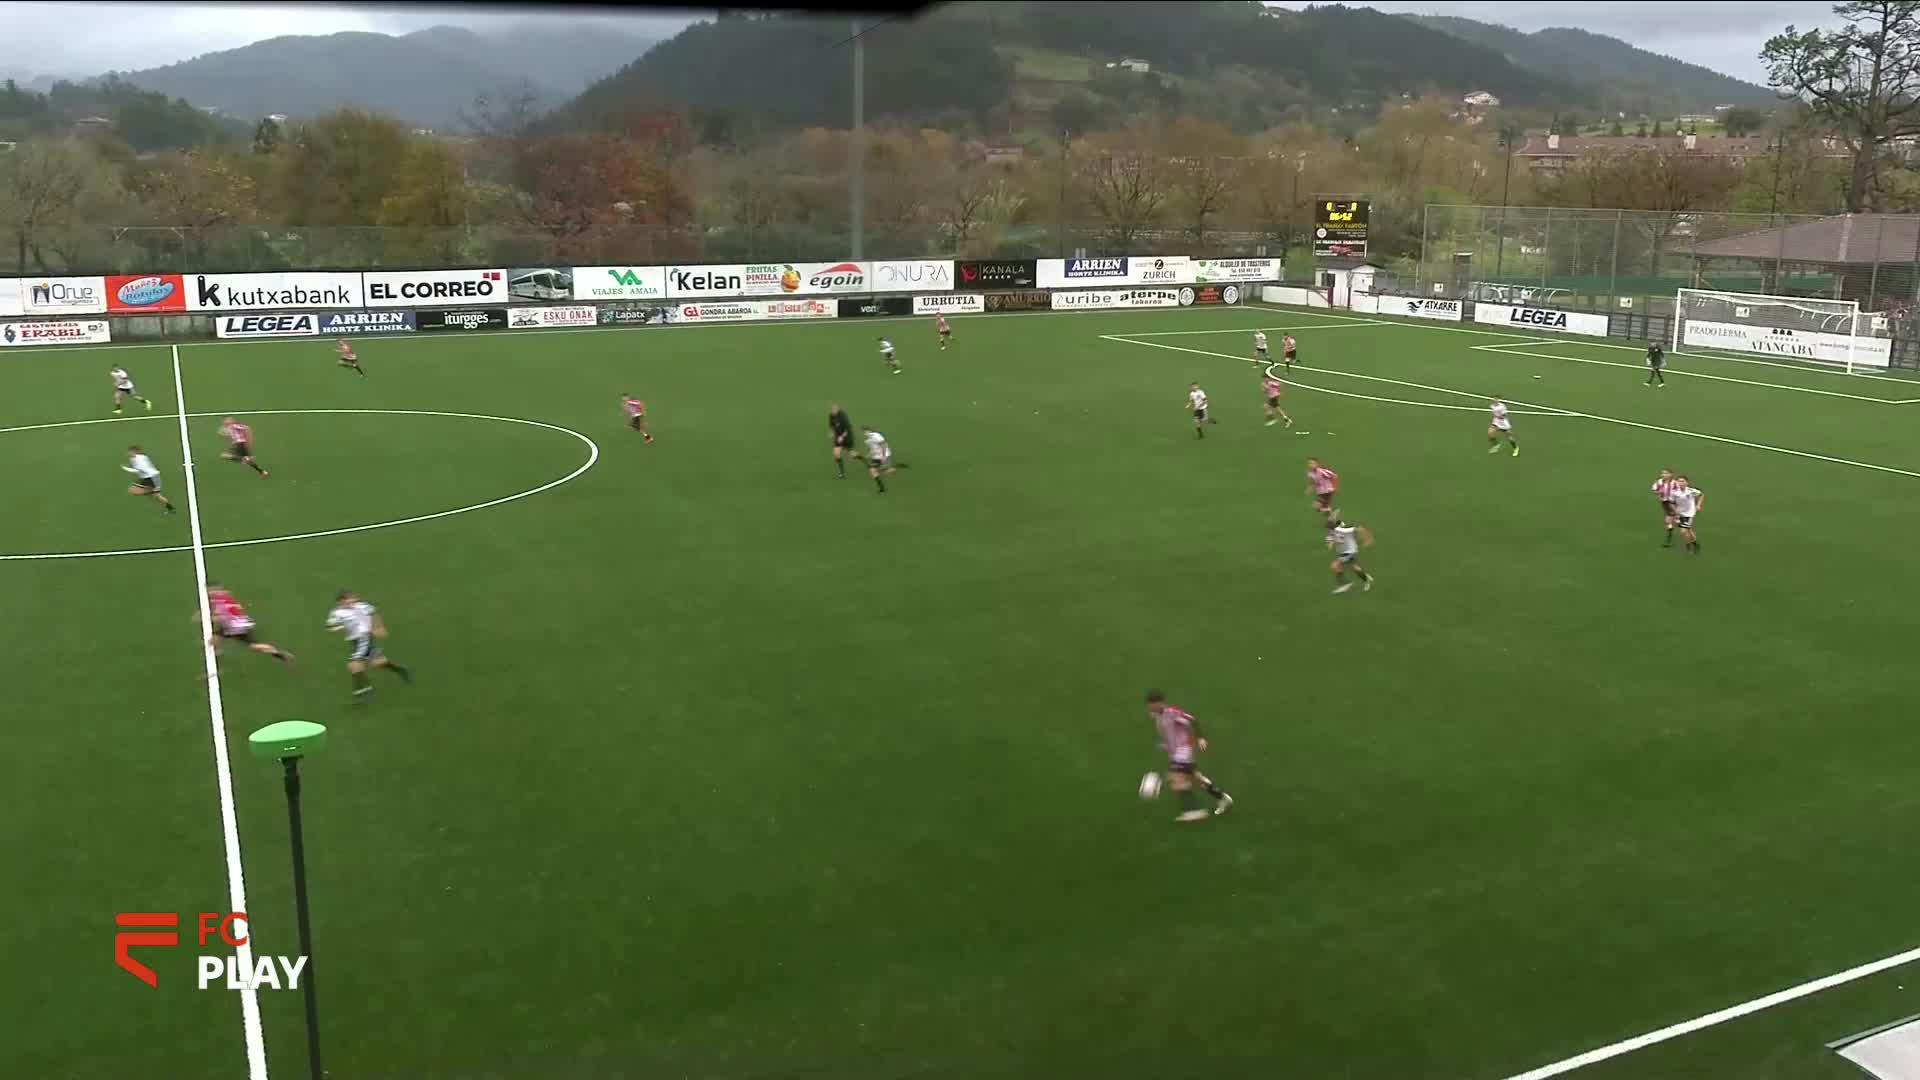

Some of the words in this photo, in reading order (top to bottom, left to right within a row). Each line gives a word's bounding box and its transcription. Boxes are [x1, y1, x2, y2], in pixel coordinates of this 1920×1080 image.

[982, 264, 1025, 274] KANALA
[1071, 258, 1122, 270] ARRIEN
[677, 271, 741, 291] Kelan
[809, 273, 864, 289] egoin
[1143, 270, 1176, 280] ZURICH
[52, 283, 93, 300] Orue
[228, 285, 351, 306] kutxabank
[370, 283, 398, 299] EL
[400, 280, 494, 299] CORREO
[592, 288, 623, 296] VIAJES
[629, 287, 658, 295] AMAIA
[922, 296, 976, 306] URRUTIA
[1065, 293, 1112, 304] uribe
[1119, 291, 1177, 301] aterpe
[1424, 300, 1457, 312] ATXARRE
[329, 312, 404, 325] ARRIEN
[444, 312, 489, 329] iturgges
[543, 311, 567, 320] ESKU
[569, 310, 593, 320] ONAK
[616, 310, 646, 319] Lapatx
[1510, 308, 1567, 328] LEGEA
[225, 315, 313, 333] LEGEA
[1689, 326, 1717, 336] PRADO
[1750, 341, 1814, 356] ATANCABA
